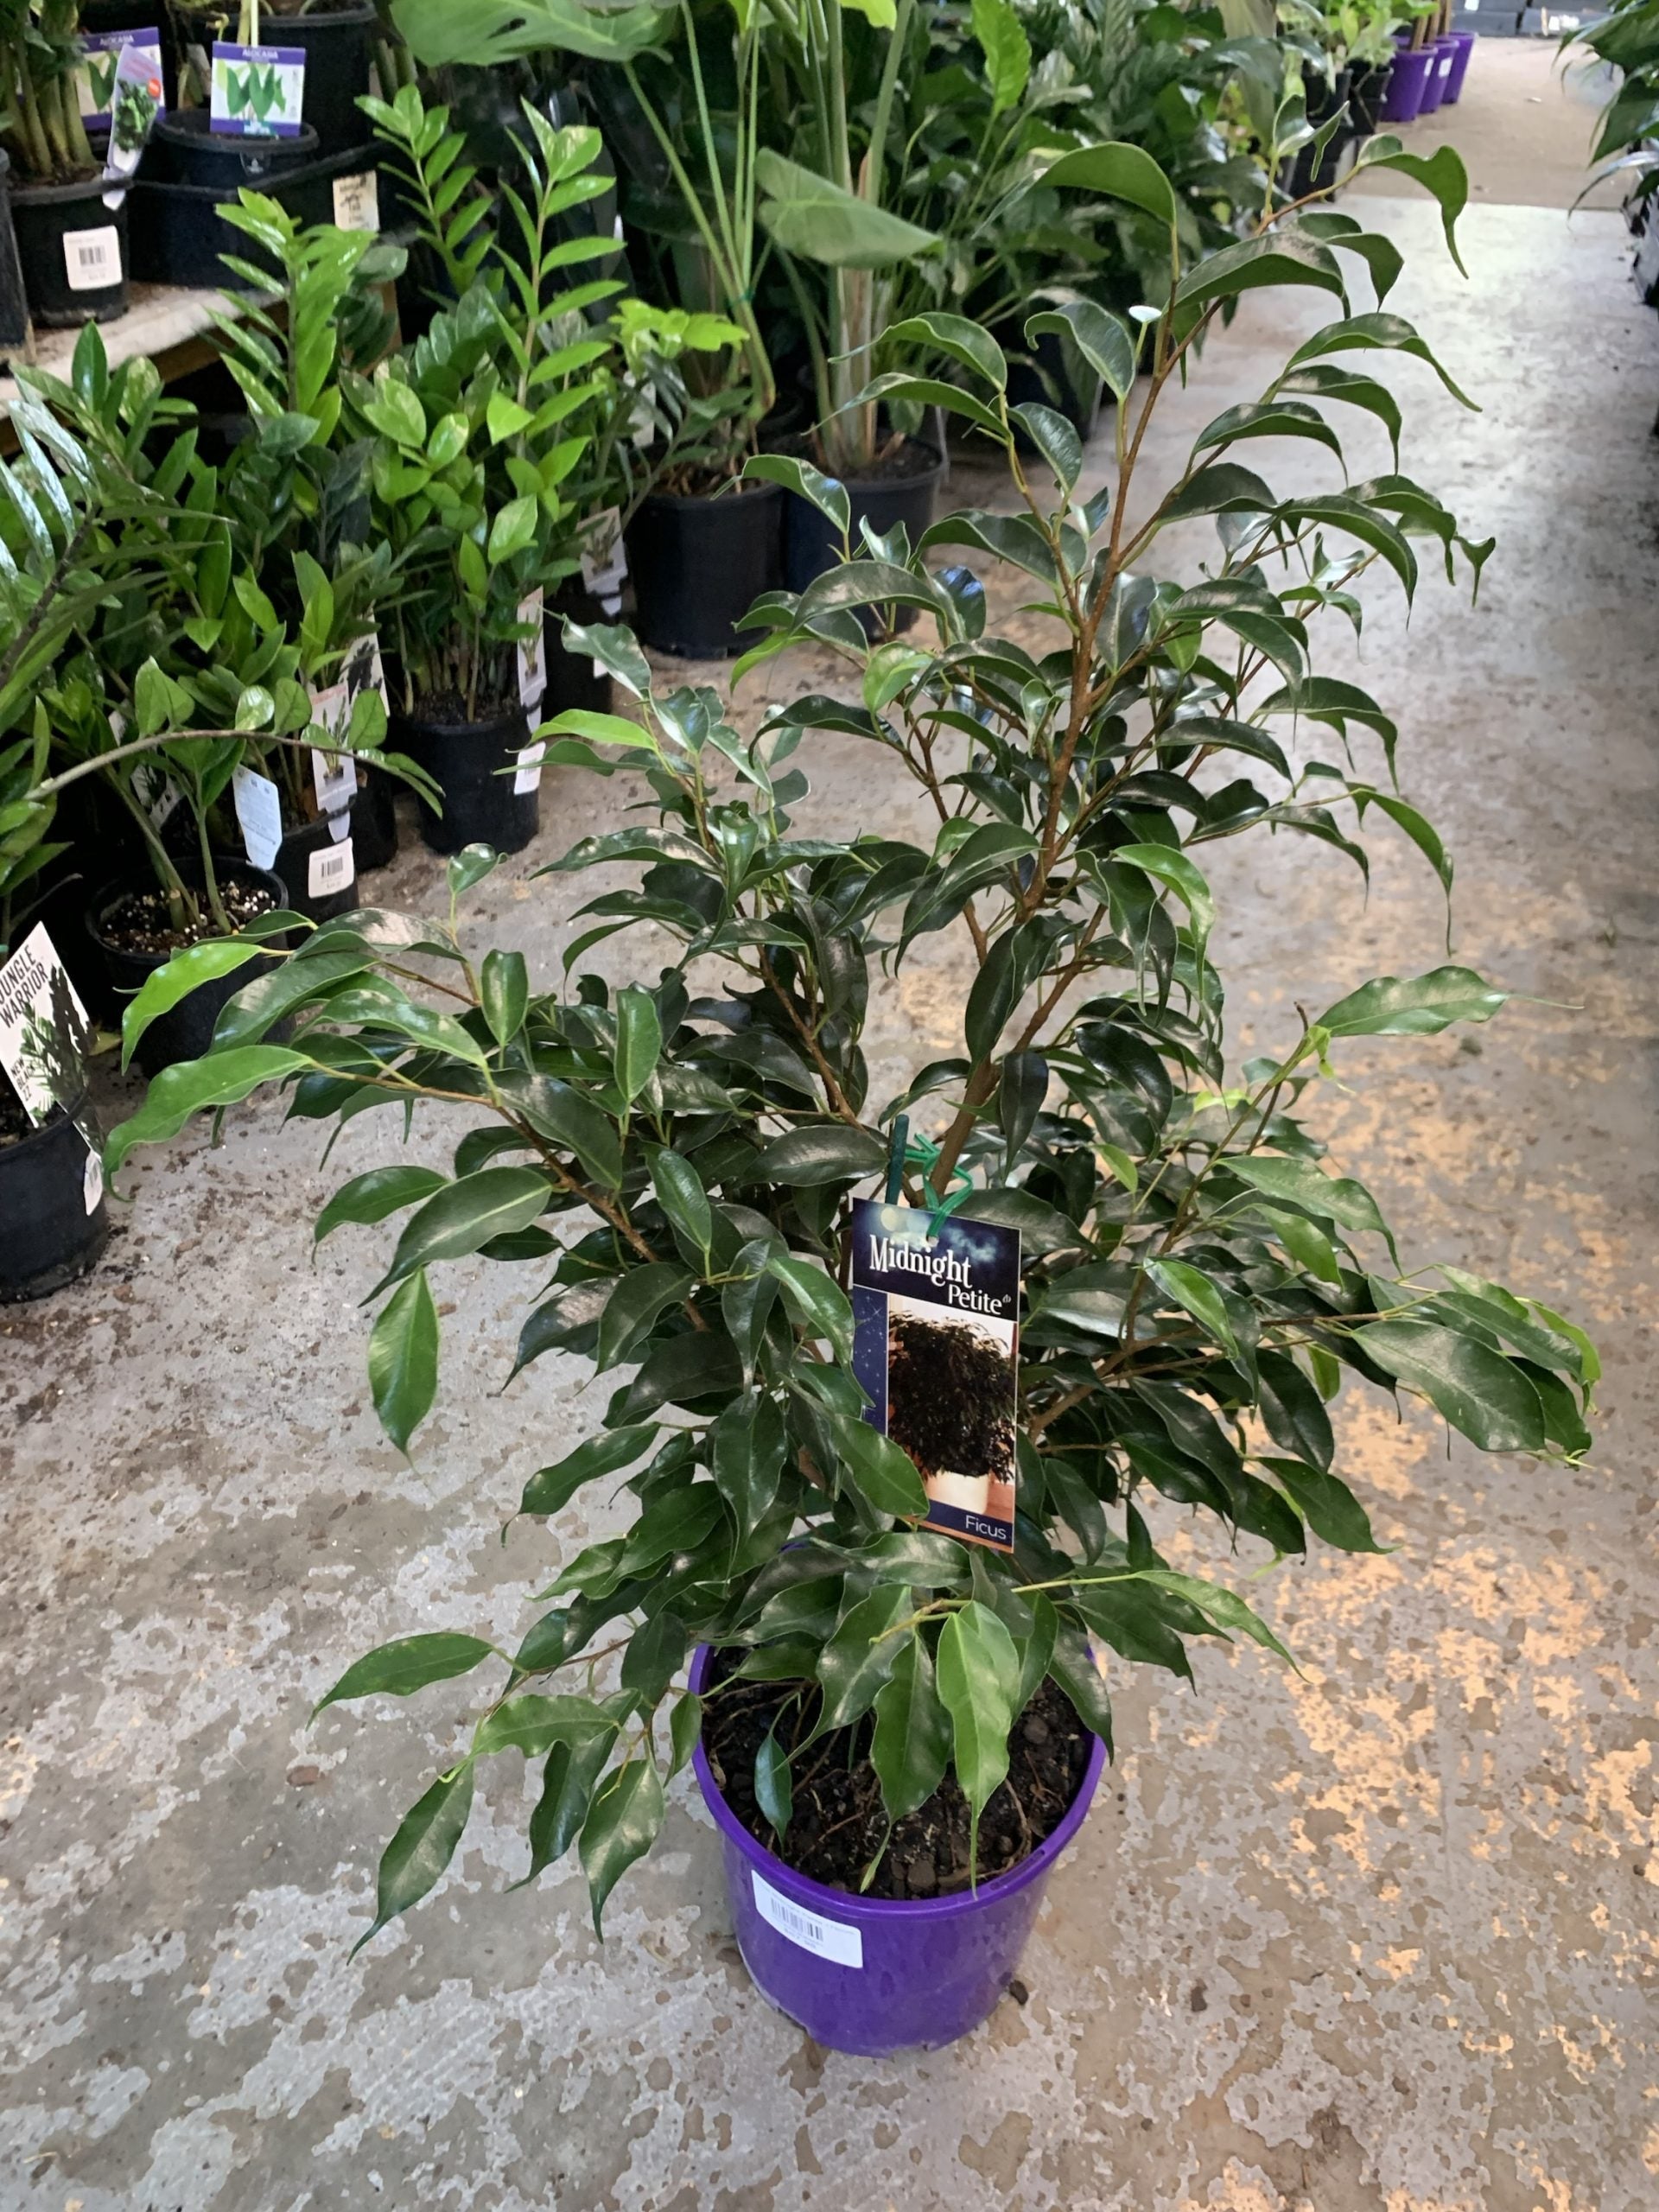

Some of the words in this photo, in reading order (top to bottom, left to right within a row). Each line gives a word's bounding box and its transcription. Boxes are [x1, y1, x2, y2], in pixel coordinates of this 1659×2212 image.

[0, 944, 35, 1005] JUNGLE
[0, 962, 48, 1028] WARRIOR
[10, 1056, 24, 1078] NEW
[16, 1064, 35, 1090] BLACK
[22, 1084, 31, 1102] ZZ
[869, 1234, 973, 1288] Midnight
[949, 1283, 1002, 1315] Petite
[965, 1514, 1007, 1540] Ficus
